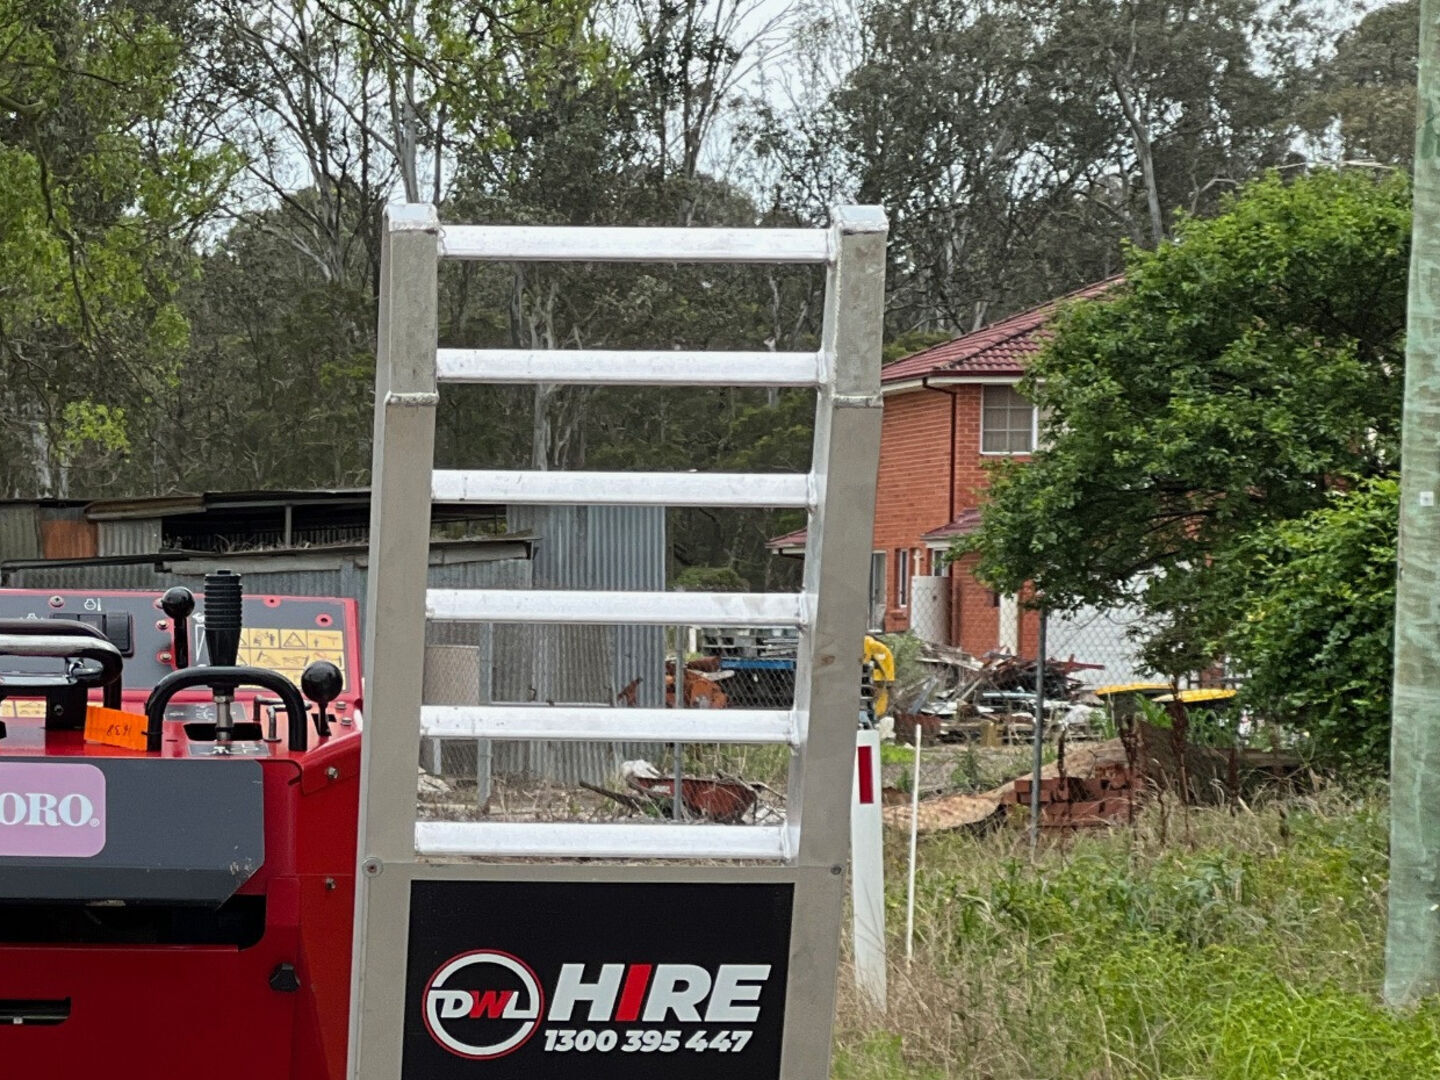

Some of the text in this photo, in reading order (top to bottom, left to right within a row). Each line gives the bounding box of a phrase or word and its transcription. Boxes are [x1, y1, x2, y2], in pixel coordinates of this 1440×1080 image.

[547, 963, 772, 1023] HIRE
[544, 1030, 754, 1053] 1300 395 447
